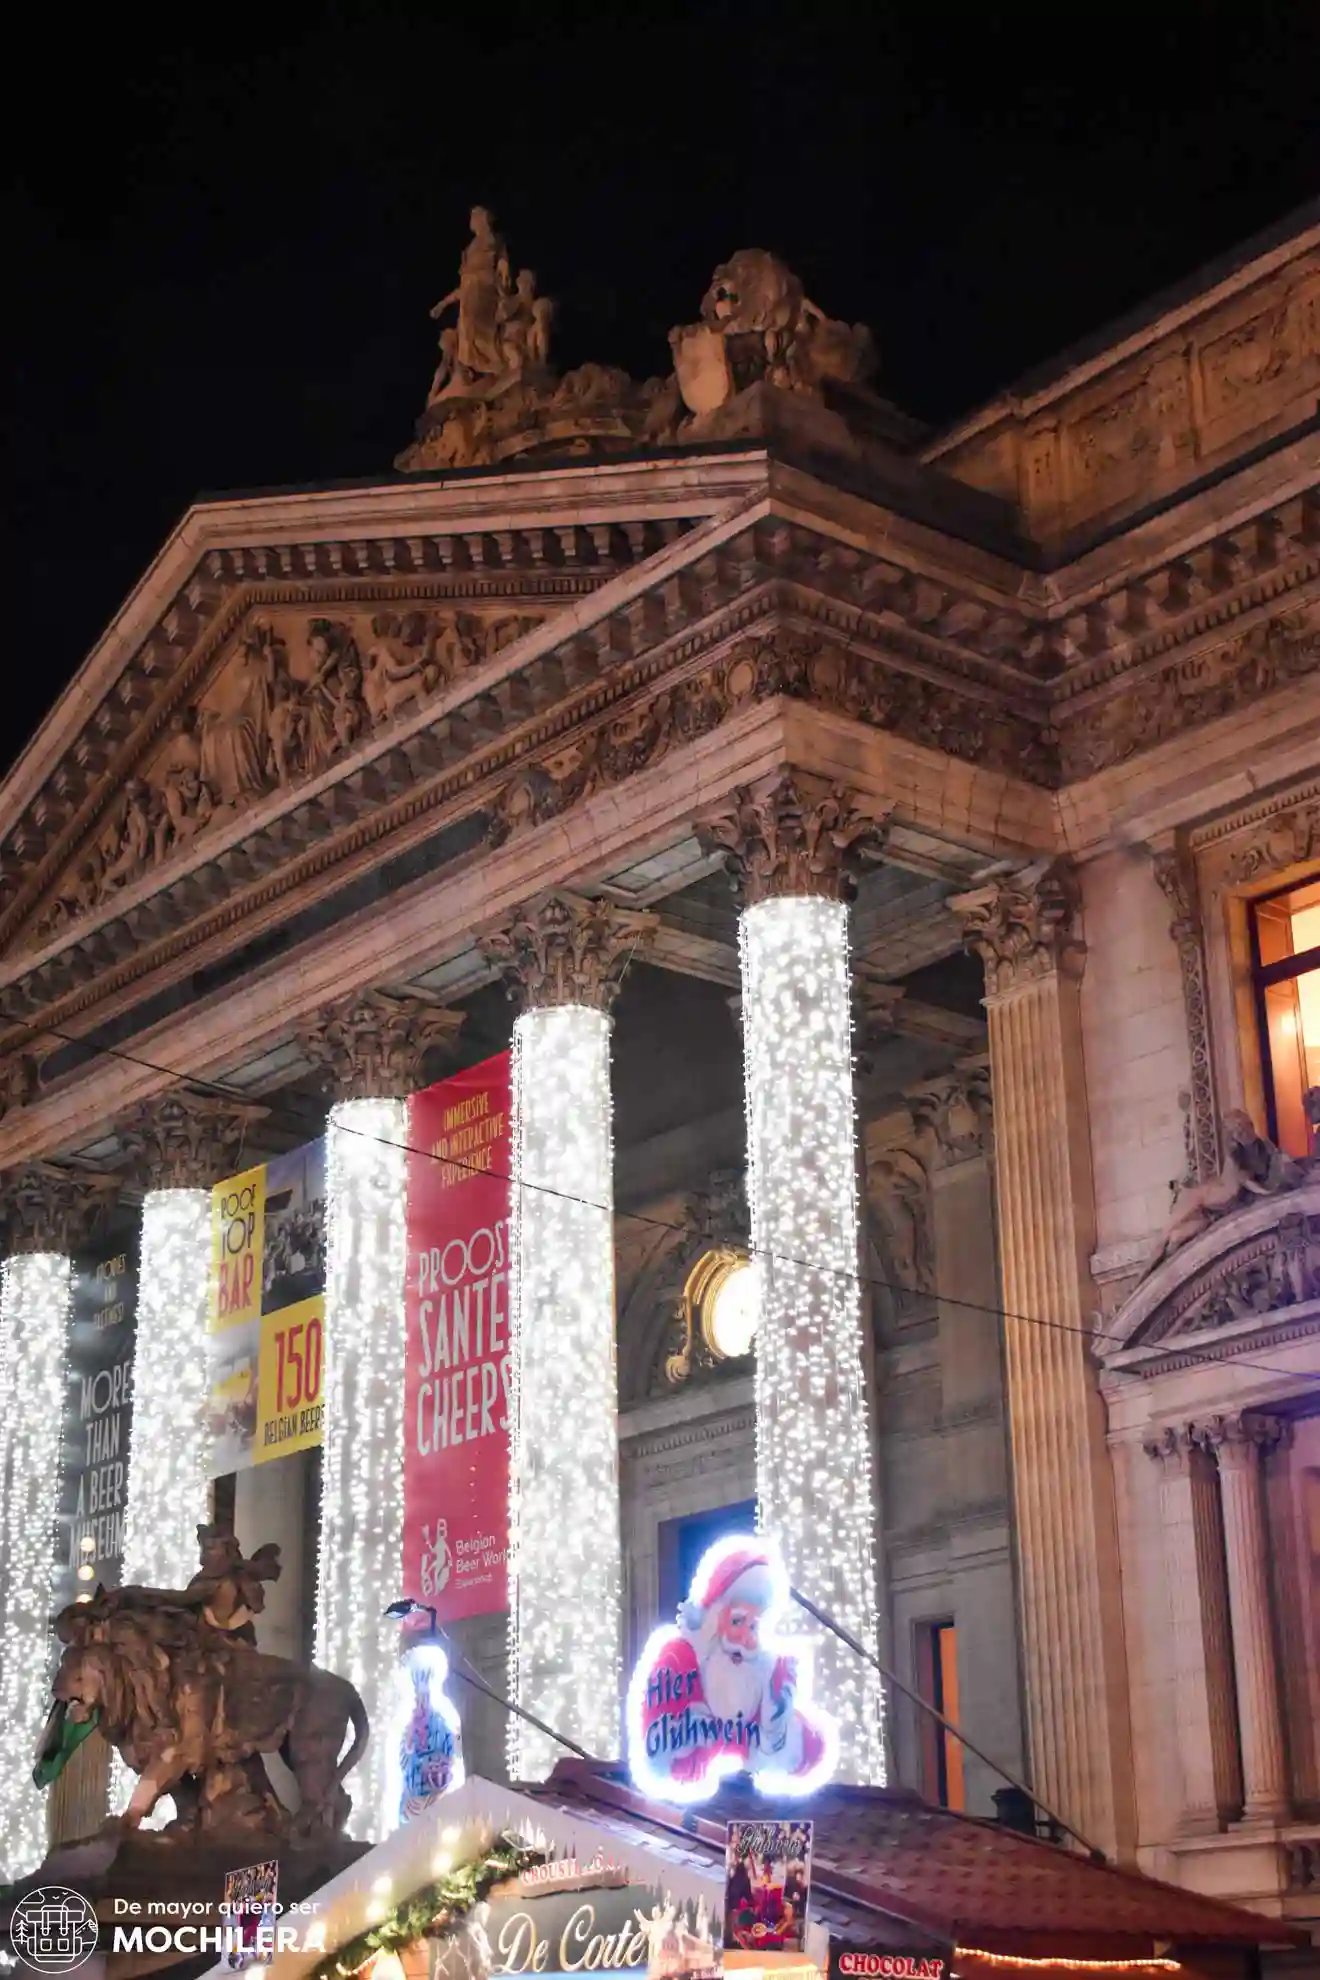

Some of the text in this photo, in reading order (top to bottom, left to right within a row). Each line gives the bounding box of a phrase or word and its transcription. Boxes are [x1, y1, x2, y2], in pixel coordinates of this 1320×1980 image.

[218, 1255, 254, 1318] BAR
[80, 1361, 130, 1420] MORE
[274, 1317, 322, 1413] 150
[85, 1412, 121, 1466] THAN
[76, 1461, 124, 1519] A BEER
[456, 1535, 496, 1556] Belgian
[456, 1558, 480, 1574] Beer
[646, 1668, 698, 1709] Hier
[645, 1707, 761, 1758] Glühwein
[499, 1904, 648, 1974] De Corte
[839, 1952, 944, 1979] CHOCOLAT
